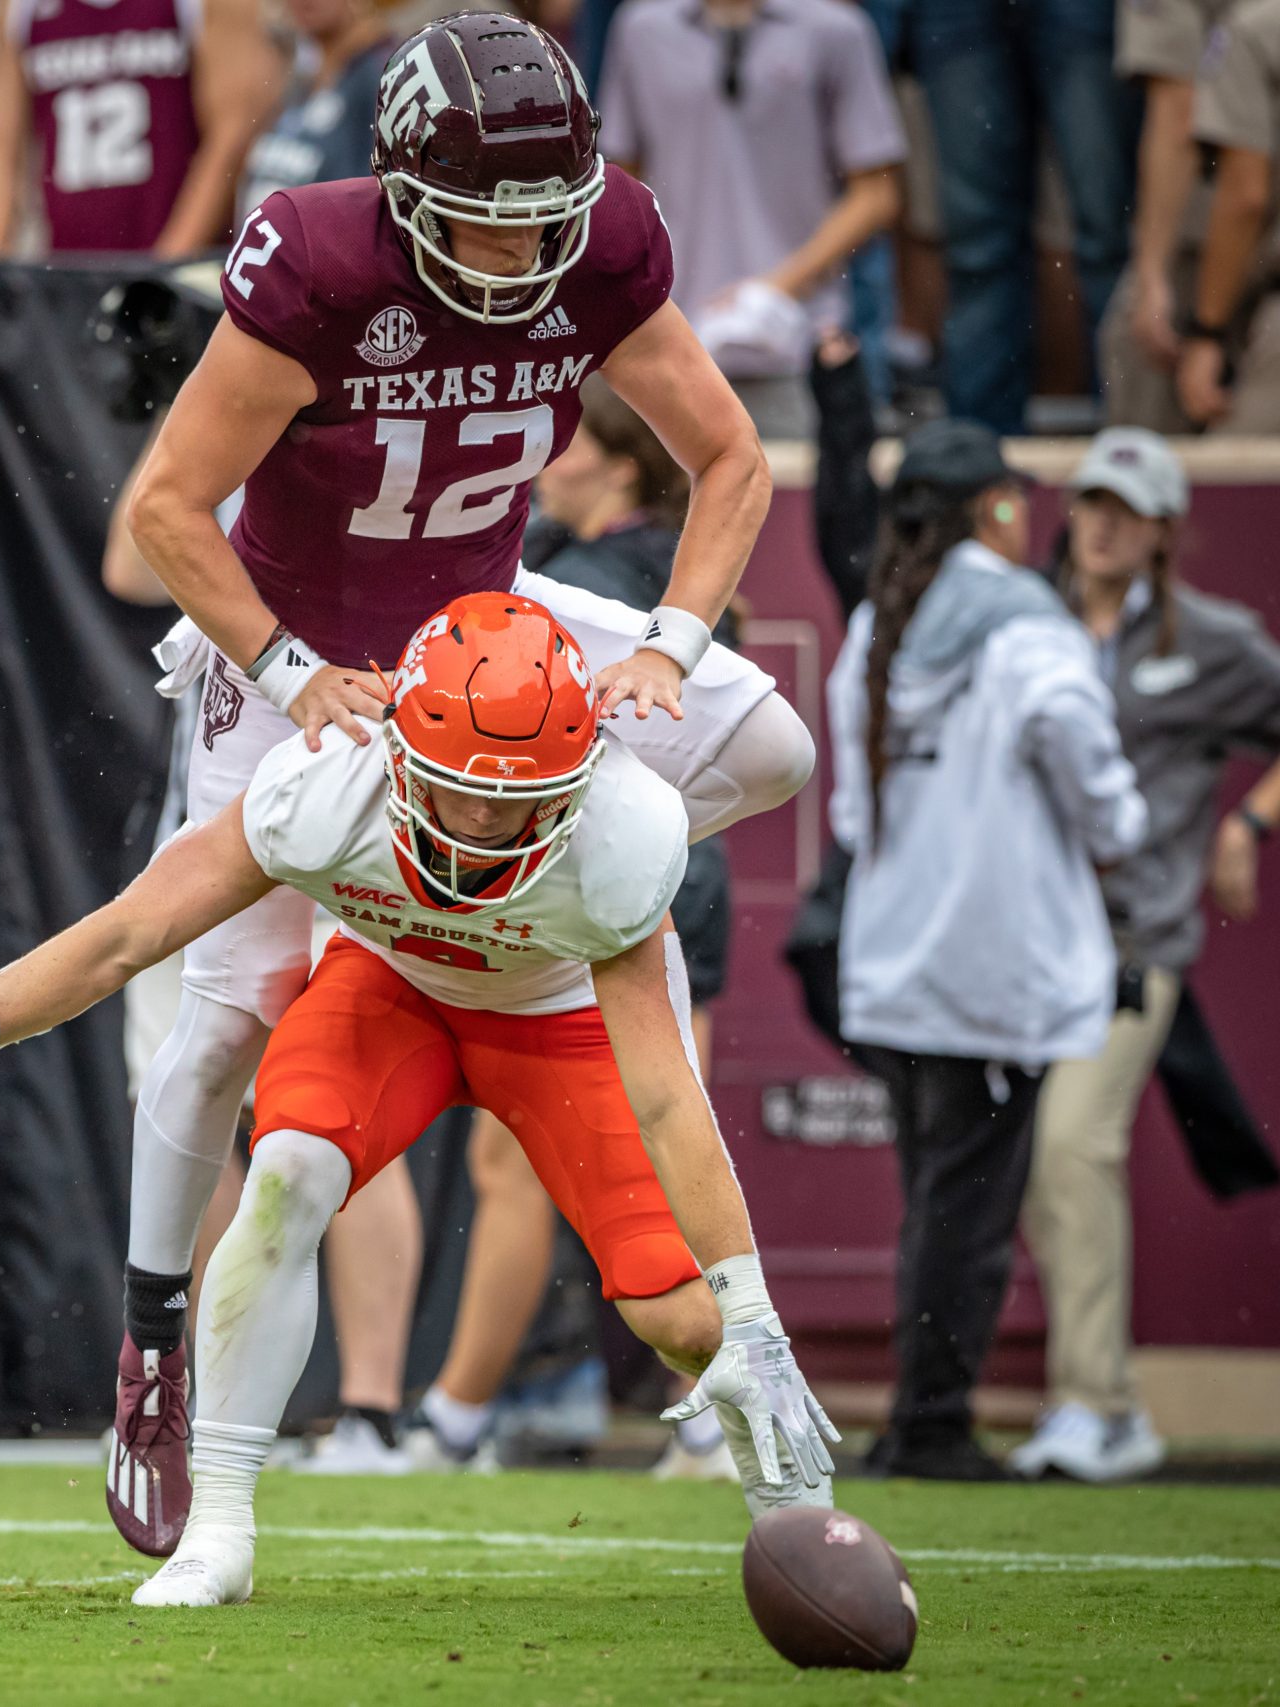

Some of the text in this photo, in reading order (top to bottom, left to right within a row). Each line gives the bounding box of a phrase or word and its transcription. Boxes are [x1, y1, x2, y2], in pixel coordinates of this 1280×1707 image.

[52, 80, 154, 192] 12
[516, 185, 546, 196] AGGIES
[225, 208, 282, 300] 12
[371, 308, 412, 352] SEC
[528, 323, 577, 340] adidas
[363, 344, 416, 366] GRADUATE
[343, 354, 594, 410] TEXAS A&M
[348, 403, 554, 541] 12
[331, 882, 408, 909] WAC
[340, 904, 402, 929] SAM
